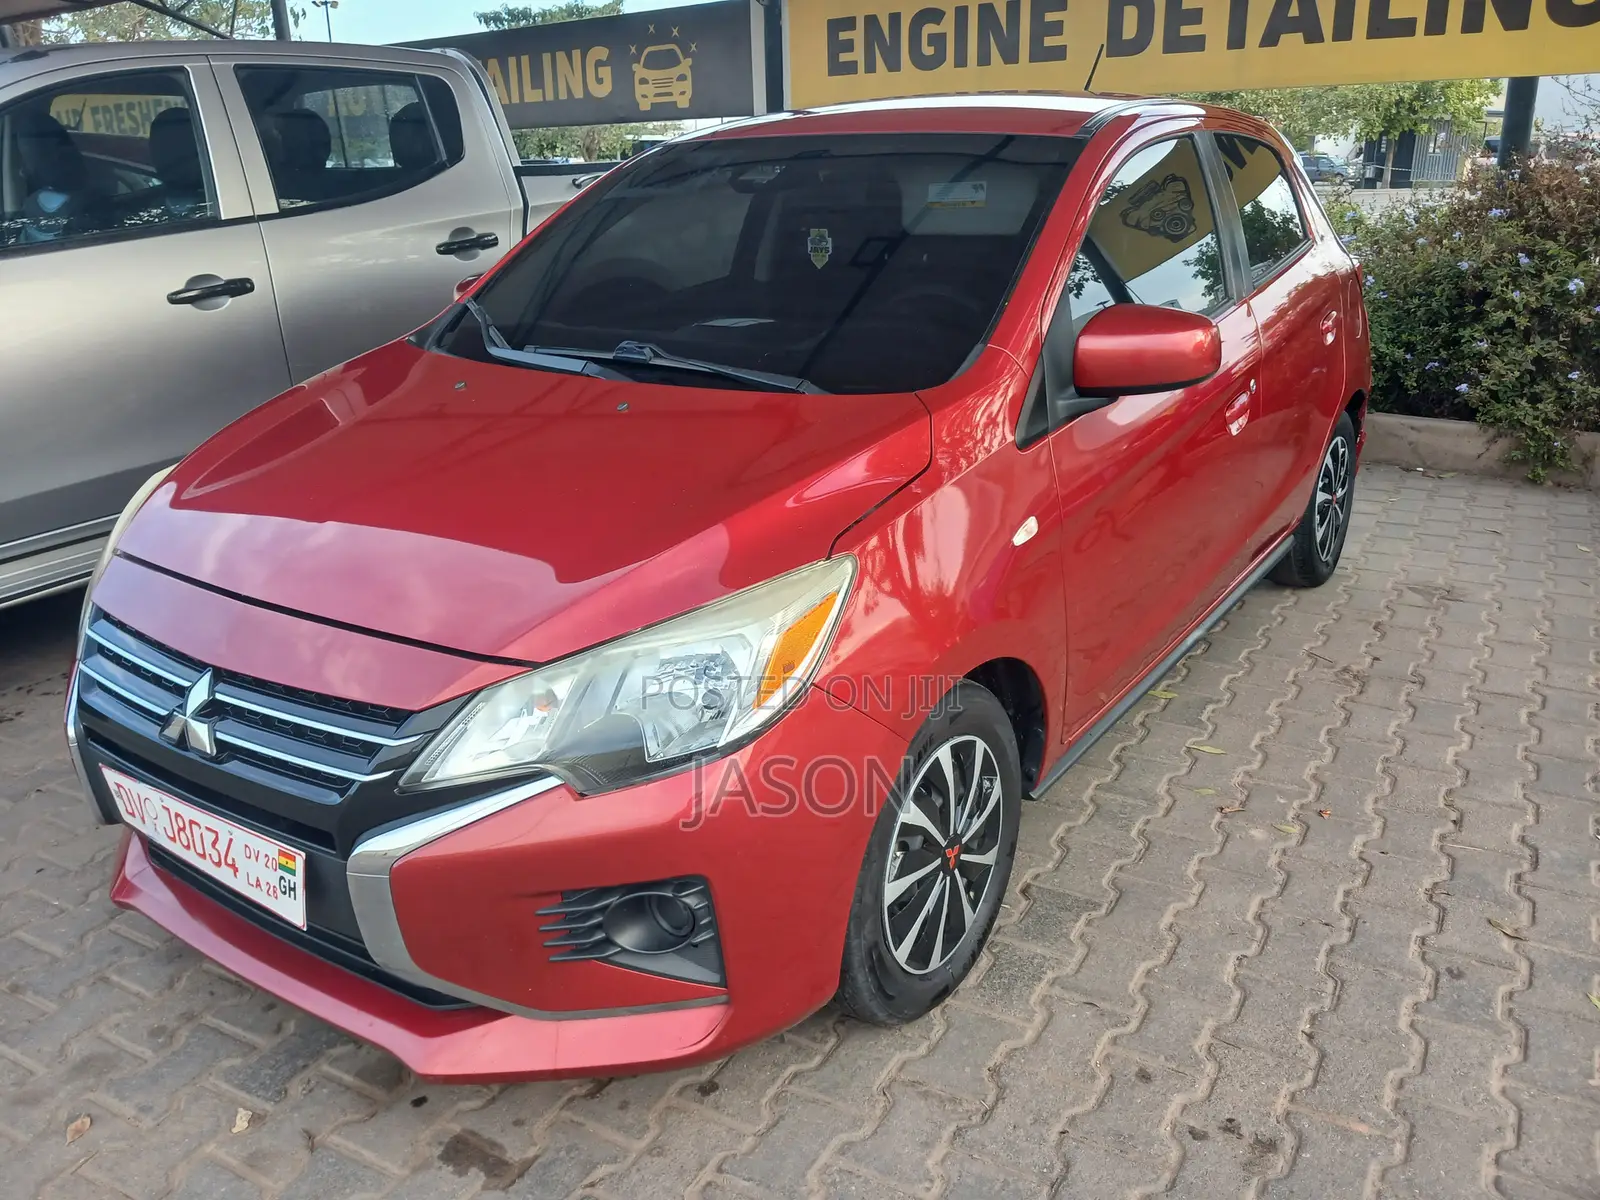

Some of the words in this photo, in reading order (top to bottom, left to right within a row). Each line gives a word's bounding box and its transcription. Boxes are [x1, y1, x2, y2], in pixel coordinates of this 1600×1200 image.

[827, 0, 1068, 77] ENGINE
[479, 46, 613, 105] AILING
[114, 782, 146, 824] DV
[161, 804, 239, 879] J8034
[244, 844, 260, 863] DV
[265, 853, 278, 872] 20
[246, 872, 263, 892] LA
[279, 875, 297, 901] GH
